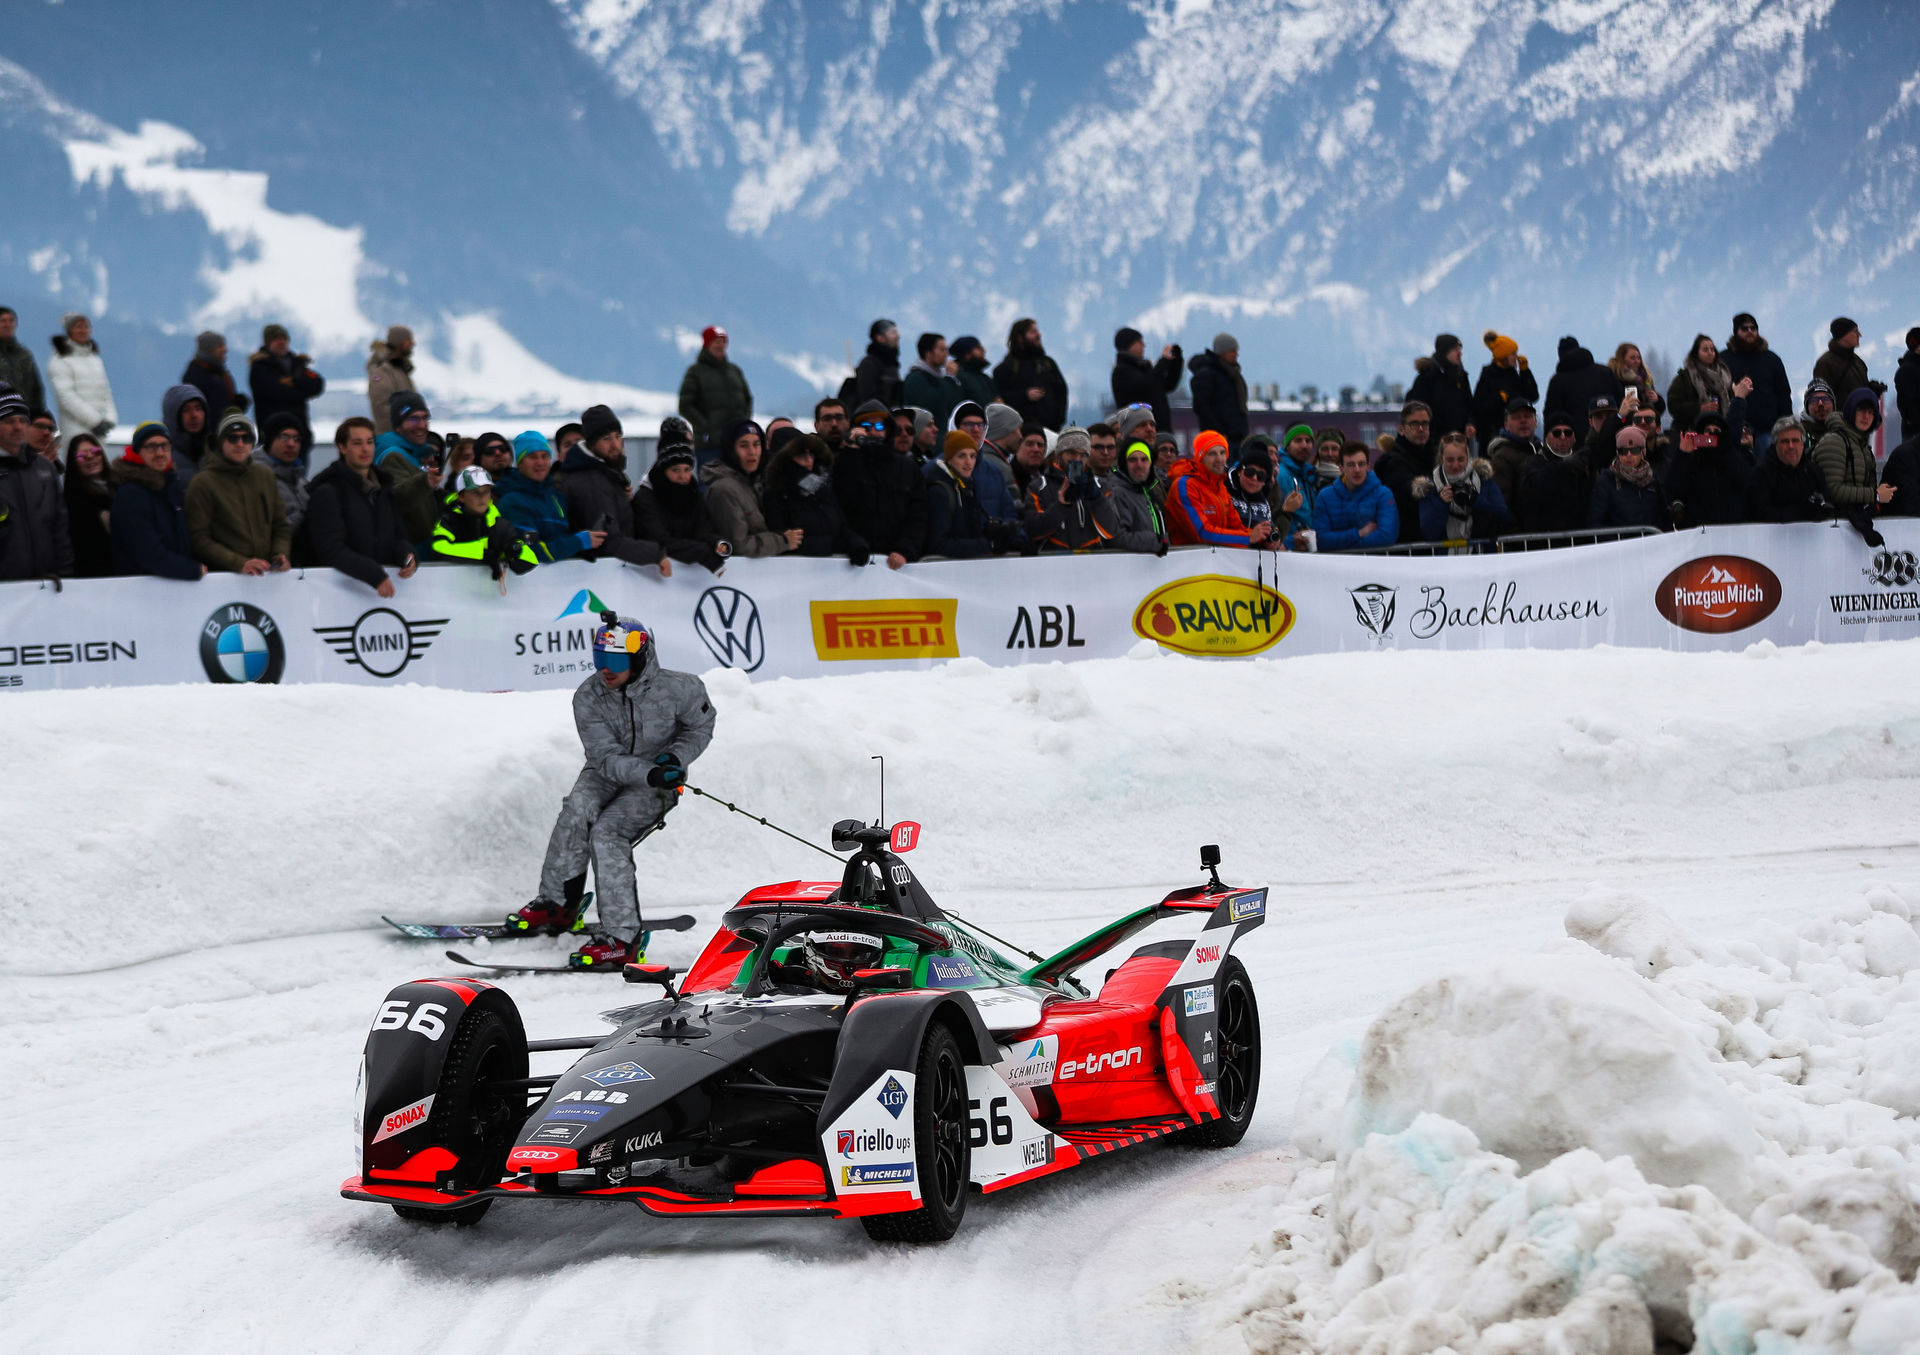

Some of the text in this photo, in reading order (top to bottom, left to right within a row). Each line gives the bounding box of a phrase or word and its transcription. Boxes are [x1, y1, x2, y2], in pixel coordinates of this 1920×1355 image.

[1674, 584, 1764, 612] Pinzgau Milch
[1829, 591, 1920, 613] WIENINGER
[1174, 599, 1272, 633] RAUCH
[1409, 581, 1608, 640] Backhausen
[205, 605, 276, 640] BMW
[823, 610, 945, 649] PIRELLI
[1006, 604, 1086, 650] ABL
[359, 633, 404, 653] MINI
[534, 662, 555, 676] Zell
[559, 663, 577, 673] am
[896, 825, 914, 848] ABT
[826, 933, 877, 946] Audi e-tron
[1196, 945, 1220, 964] SONAX
[932, 962, 961, 981] Julius
[372, 1000, 448, 1041] 66
[1008, 1060, 1056, 1080] SCHMITTEN
[1059, 1046, 1142, 1080] e-tron
[592, 1070, 644, 1080] LGT
[555, 1089, 630, 1104] ABB
[882, 1090, 905, 1106] LGT
[386, 1104, 426, 1132] SONAX
[968, 1096, 1013, 1148] 66
[625, 1130, 663, 1153] KUKA
[857, 1128, 911, 1153] riello ups
[864, 1168, 912, 1180] MICHELIN
